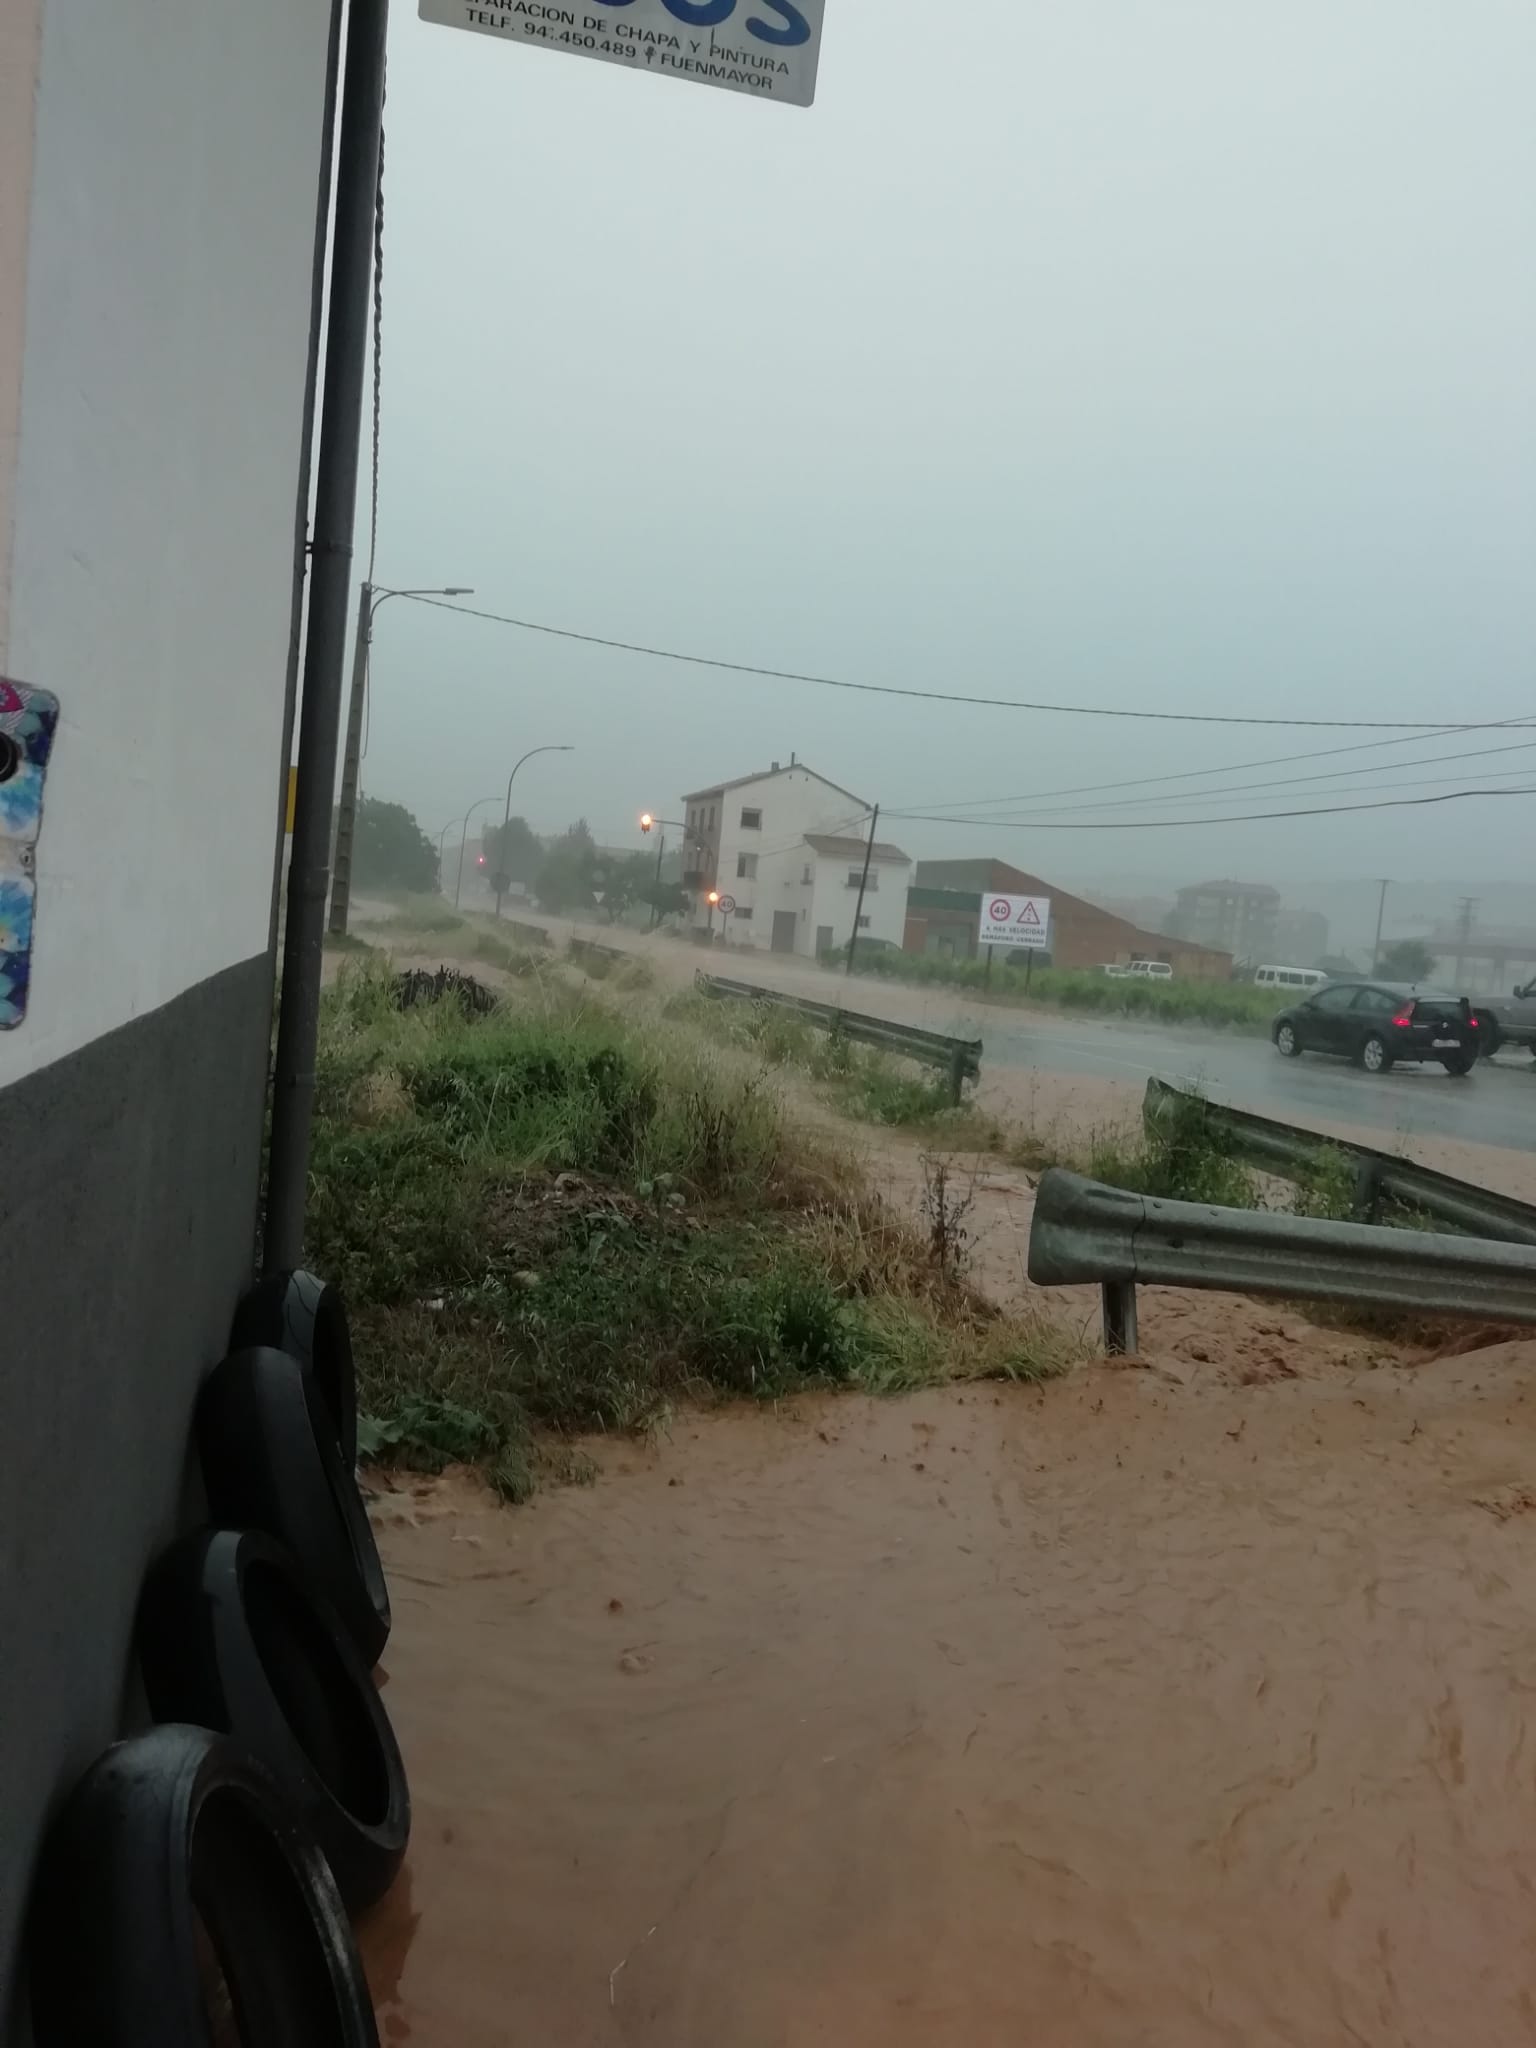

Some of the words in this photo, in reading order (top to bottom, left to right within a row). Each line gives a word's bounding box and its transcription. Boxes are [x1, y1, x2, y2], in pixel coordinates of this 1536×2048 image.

[464, 0, 575, 25] ARACION
[583, 16, 608, 33] DE
[615, 24, 681, 50] CHAPA
[690, 39, 701, 54] Y
[709, 44, 790, 76] PINTURA
[466, 8, 515, 32] TELF.
[661, 53, 773, 91] FUENMAYOR
[721, 900, 732, 908] 40
[994, 905, 1006, 914] 40
